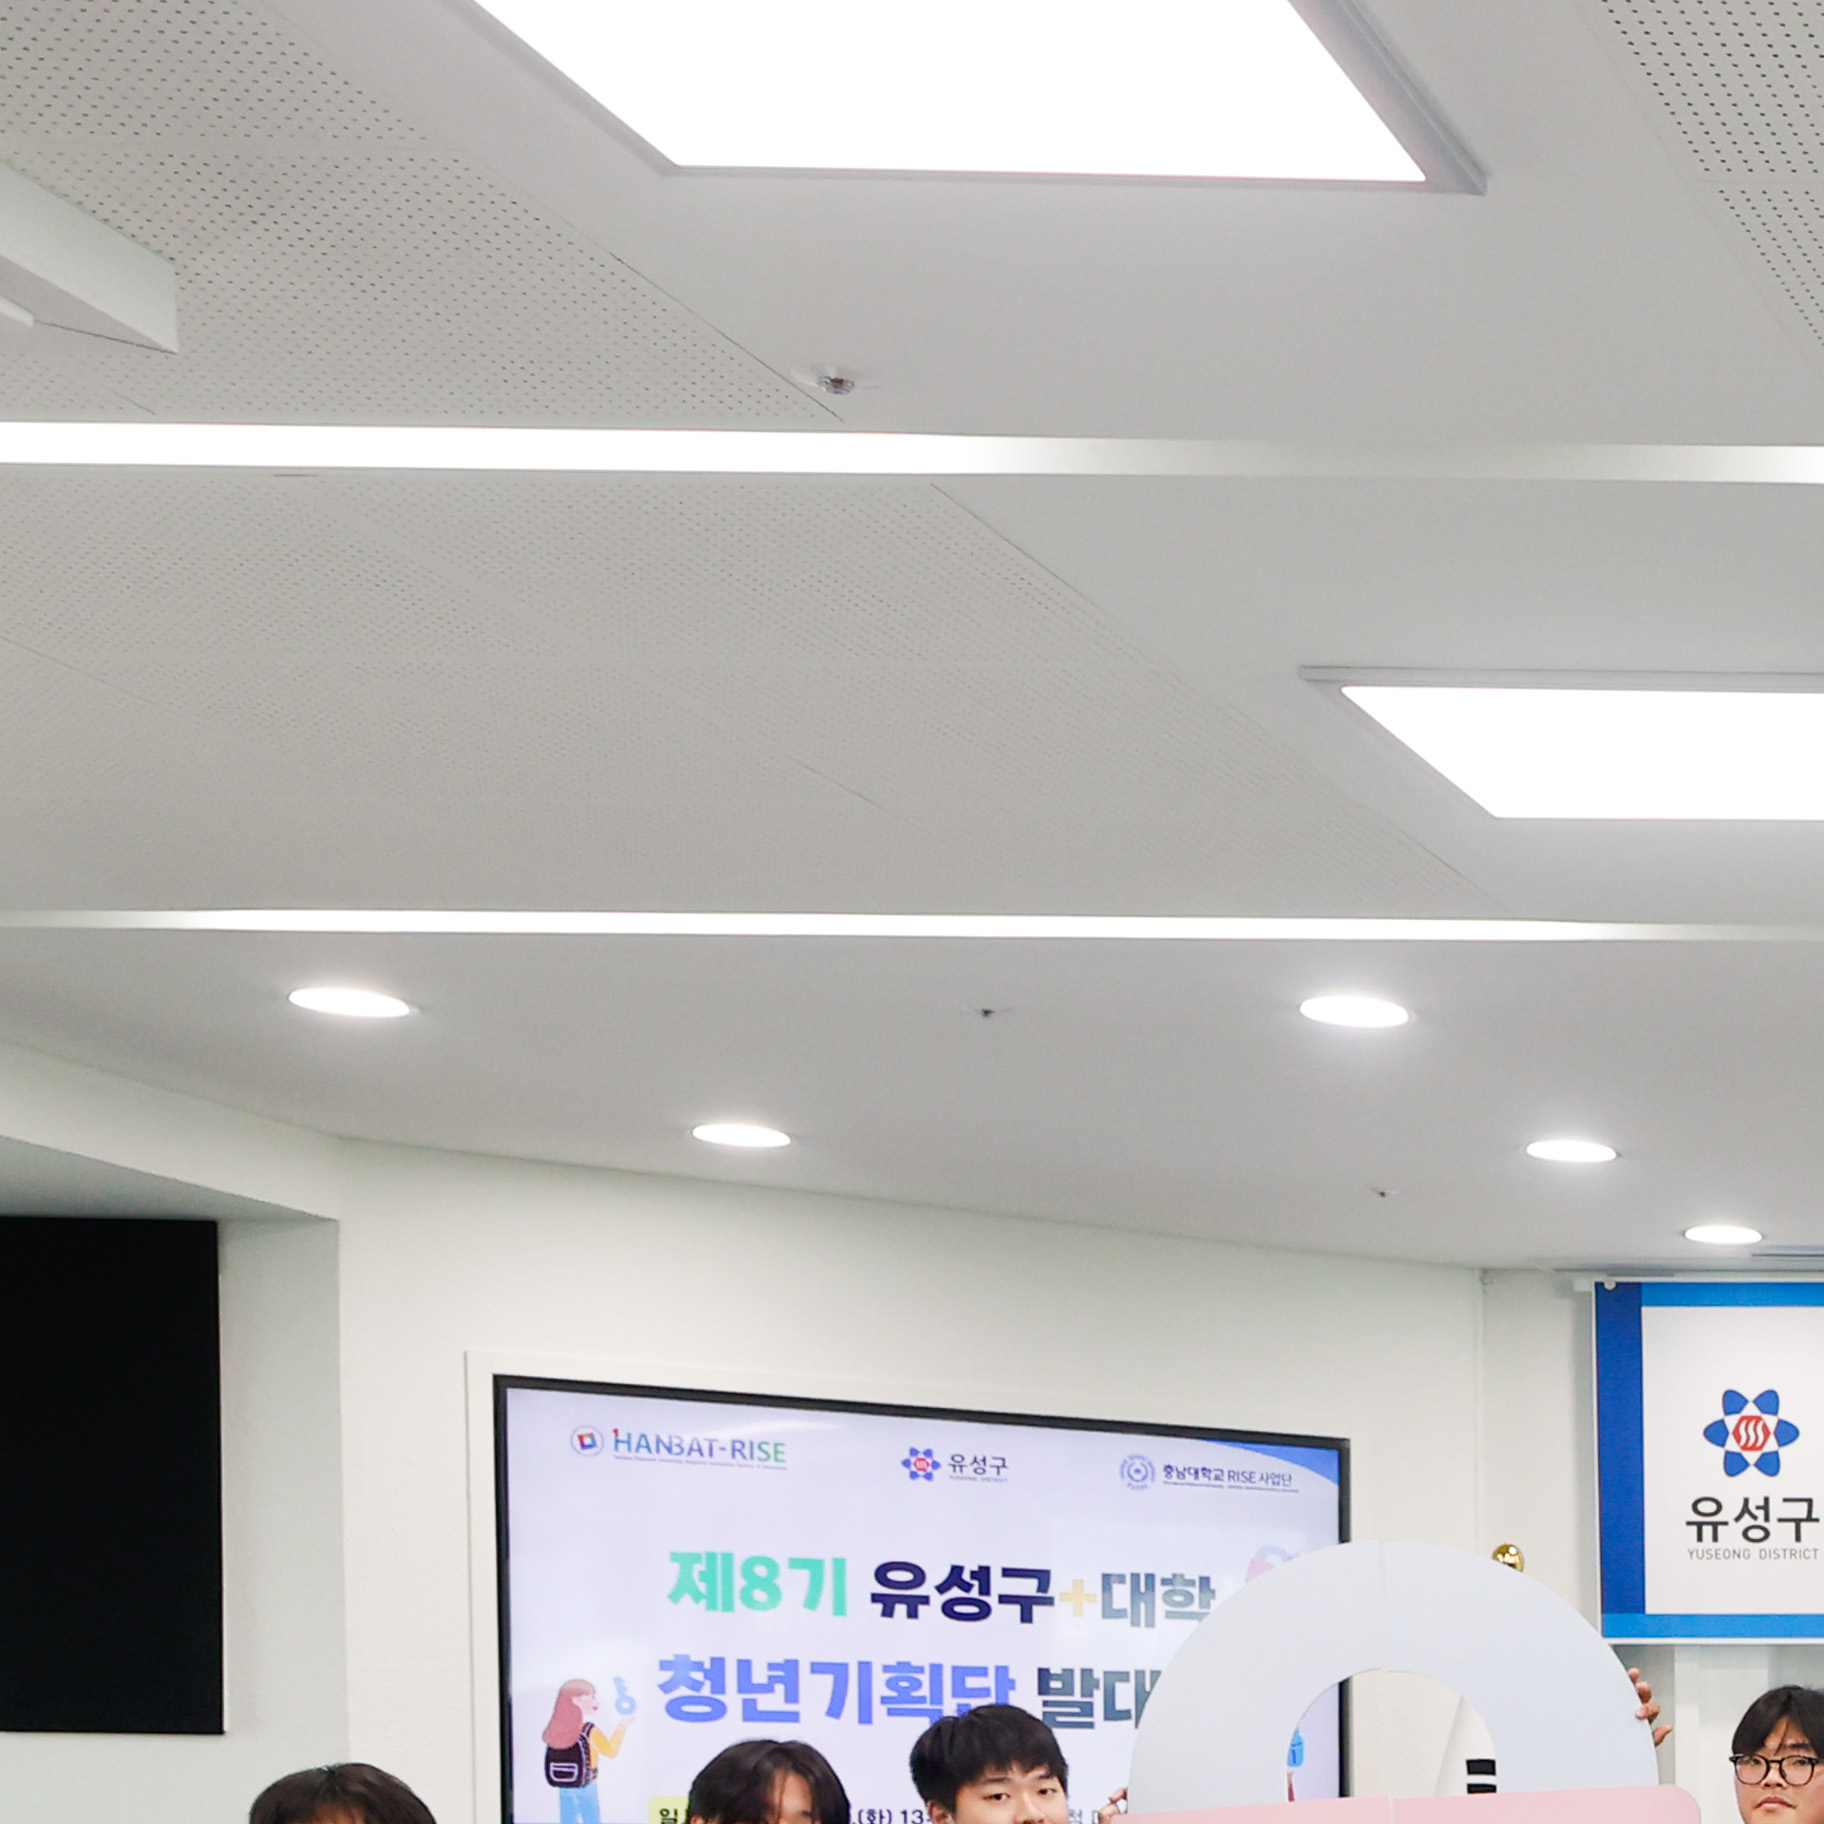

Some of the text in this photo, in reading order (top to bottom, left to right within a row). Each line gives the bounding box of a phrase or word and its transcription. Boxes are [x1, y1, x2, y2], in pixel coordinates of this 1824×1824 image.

[948, 1454, 1010, 1477] 유성구
[1163, 1464, 1225, 1483] 충남대학교
[1227, 1468, 1258, 1485] RISE
[1259, 1470, 1293, 1488] 사업단
[1685, 1495, 1821, 1544] 유성구
[1687, 1547, 1820, 1561] YUSEONG DISTRICT
[667, 1548, 848, 1618] 제8기
[1036, 1667, 1162, 1730] 발대
